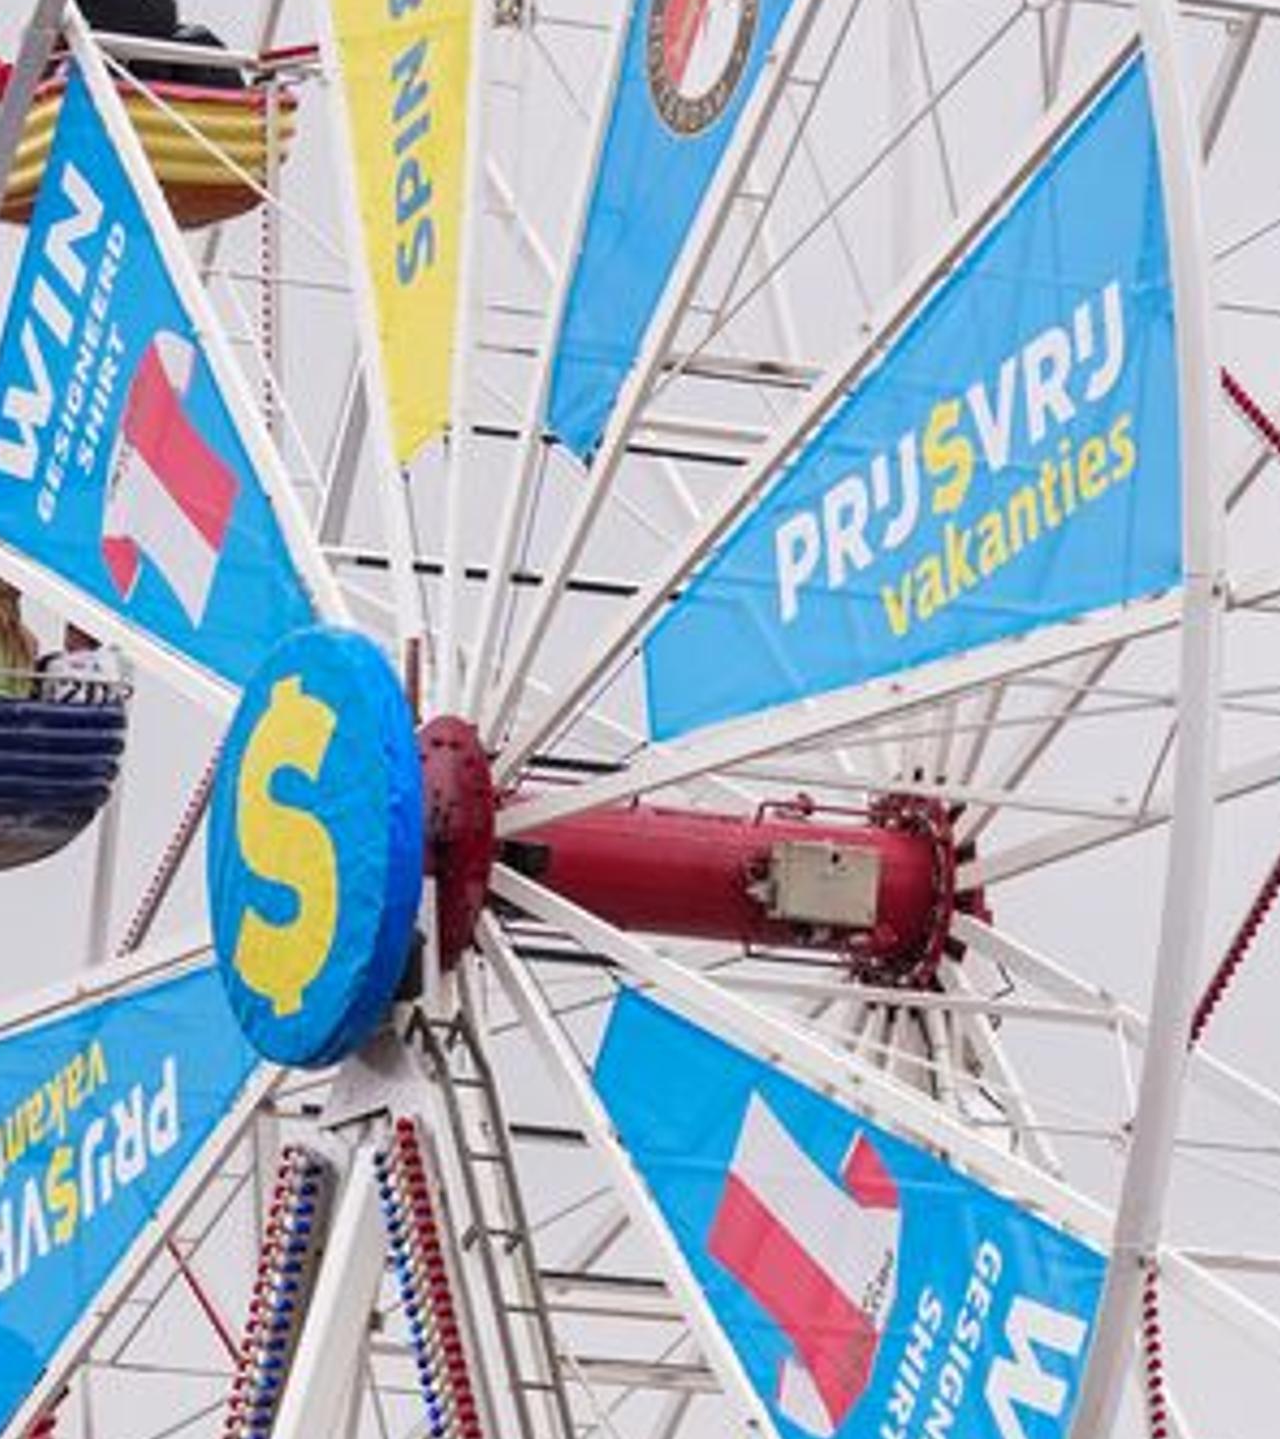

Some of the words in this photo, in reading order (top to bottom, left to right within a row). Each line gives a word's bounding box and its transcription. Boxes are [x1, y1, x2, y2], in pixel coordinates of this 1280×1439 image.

[393, 36, 434, 285] SPIN
[36, 221, 126, 523] GESIGNEERD
[76, 321, 126, 475] SHIRT
[881, 413, 1137, 636] vakanties
